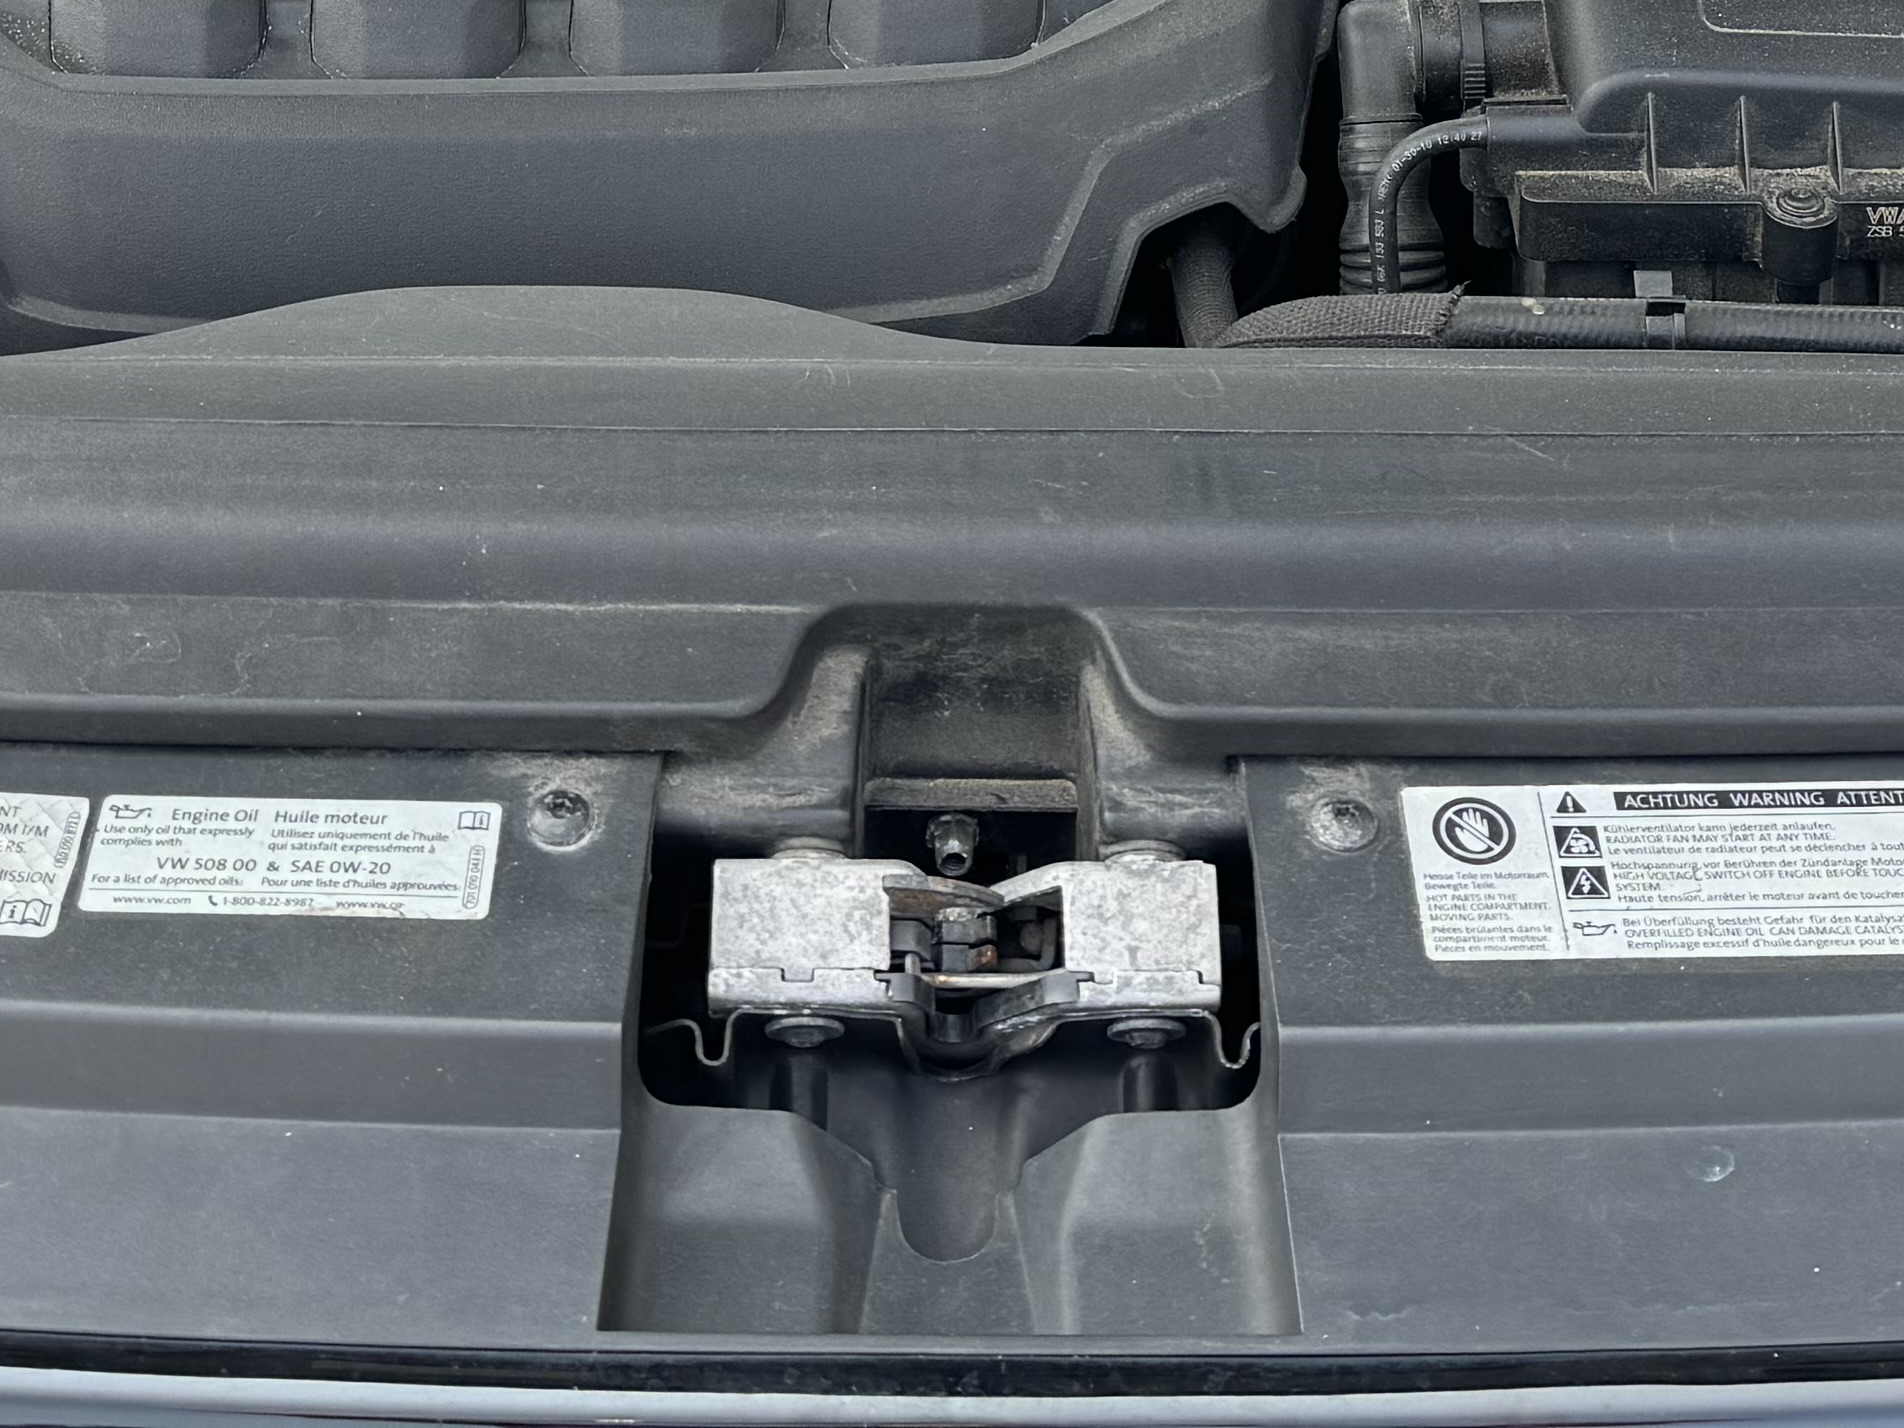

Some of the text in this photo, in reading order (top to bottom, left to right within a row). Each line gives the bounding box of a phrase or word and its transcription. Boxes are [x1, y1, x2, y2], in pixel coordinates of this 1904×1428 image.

[1866, 226, 1892, 238] ZSB
[1624, 794, 1718, 809] ACHTUNG
[1730, 791, 1825, 807] WARNING
[172, 808, 389, 825] Engine Oil Huile moteur
[21, 825, 49, 838] I/M
[104, 824, 255, 838] Use only oil that expressly
[1603, 821, 1836, 834] Kühlerventilator kann jederzeit anlaufen.
[100, 837, 183, 847] complies with
[271, 829, 449, 842] Utilisez uniquement de l'huile
[1605, 832, 1835, 844] RADIATOR FAN MAY START AT ANY TIME.
[268, 841, 436, 854] qui satisfait expressément à
[156, 856, 391, 874] VW 508 00 & SAE 0W-20
[91, 874, 110, 883] For
[124, 874, 141, 884] list
[145, 874, 158, 884] of
[160, 875, 216, 887] approved
[1613, 871, 1646, 881] HIGH
[1704, 867, 1752, 879] SWITCH
[1754, 868, 1775, 878] OFF
[1778, 867, 1823, 878] ENGINE
[1826, 867, 1870, 878] BEFORE
[261, 876, 288, 887] Pour
[291, 879, 313, 888] une
[316, 878, 340, 888] liste
[345, 879, 387, 890] d'huiles
[113, 895, 191, 905] www.vw.com
[1624, 927, 1694, 938] OVERFILLED
[1697, 926, 1743, 937] ENGINE
[1745, 926, 1764, 937] OIL
[1769, 925, 1796, 936] CAN
[1798, 925, 1852, 936] DAMAGE
